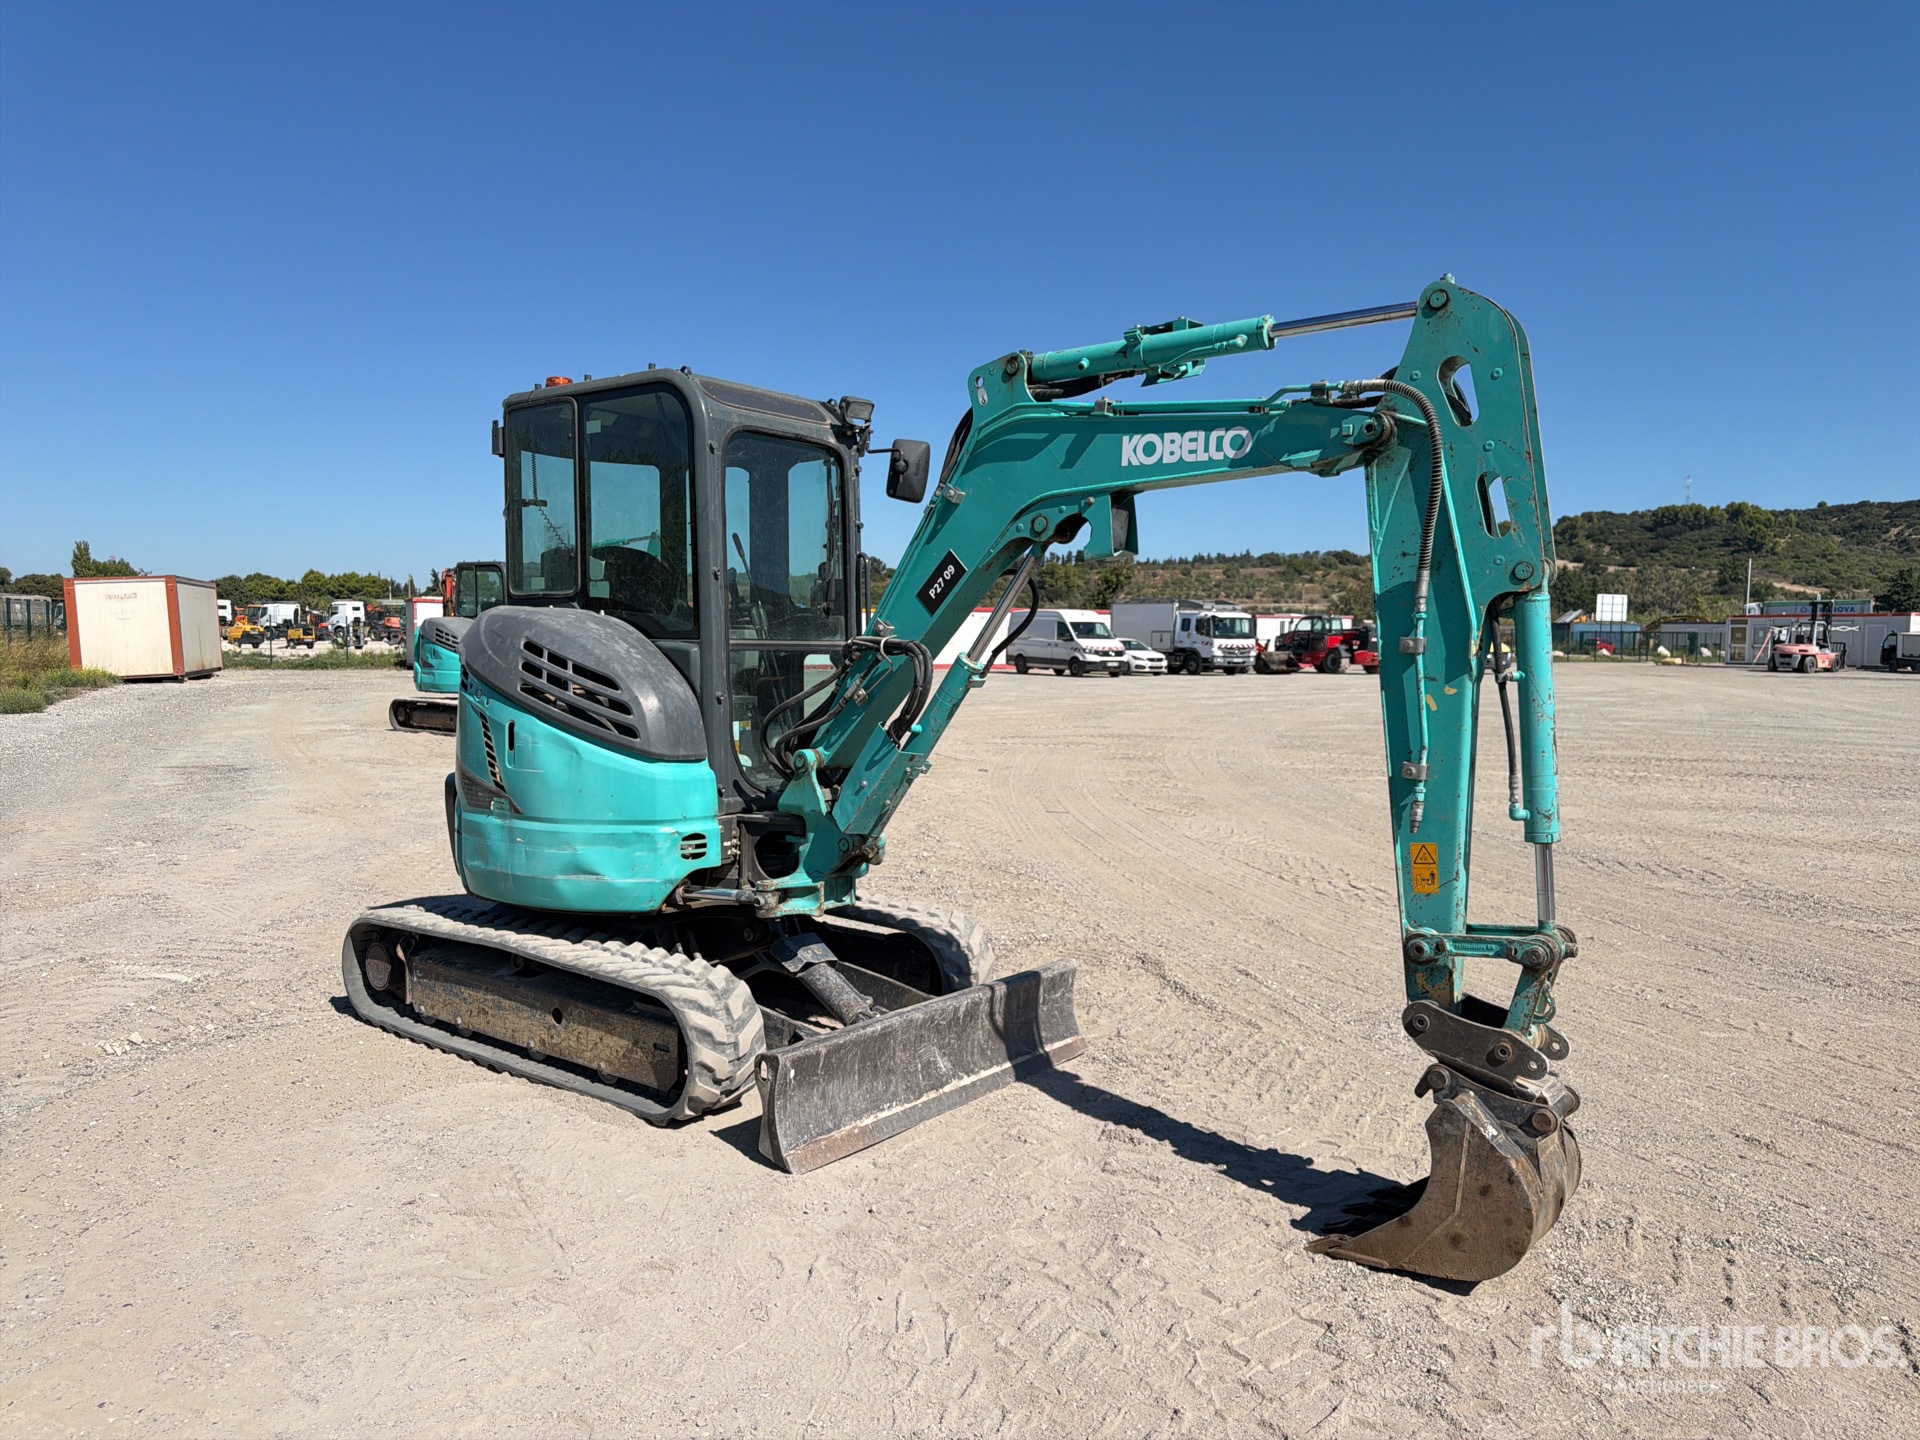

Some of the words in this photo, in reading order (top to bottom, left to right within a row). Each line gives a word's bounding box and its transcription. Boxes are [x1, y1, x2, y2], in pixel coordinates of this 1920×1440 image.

[1121, 426, 1252, 466] KOBELCO
[928, 577, 944, 599] P27
[943, 564, 955, 580] 09
